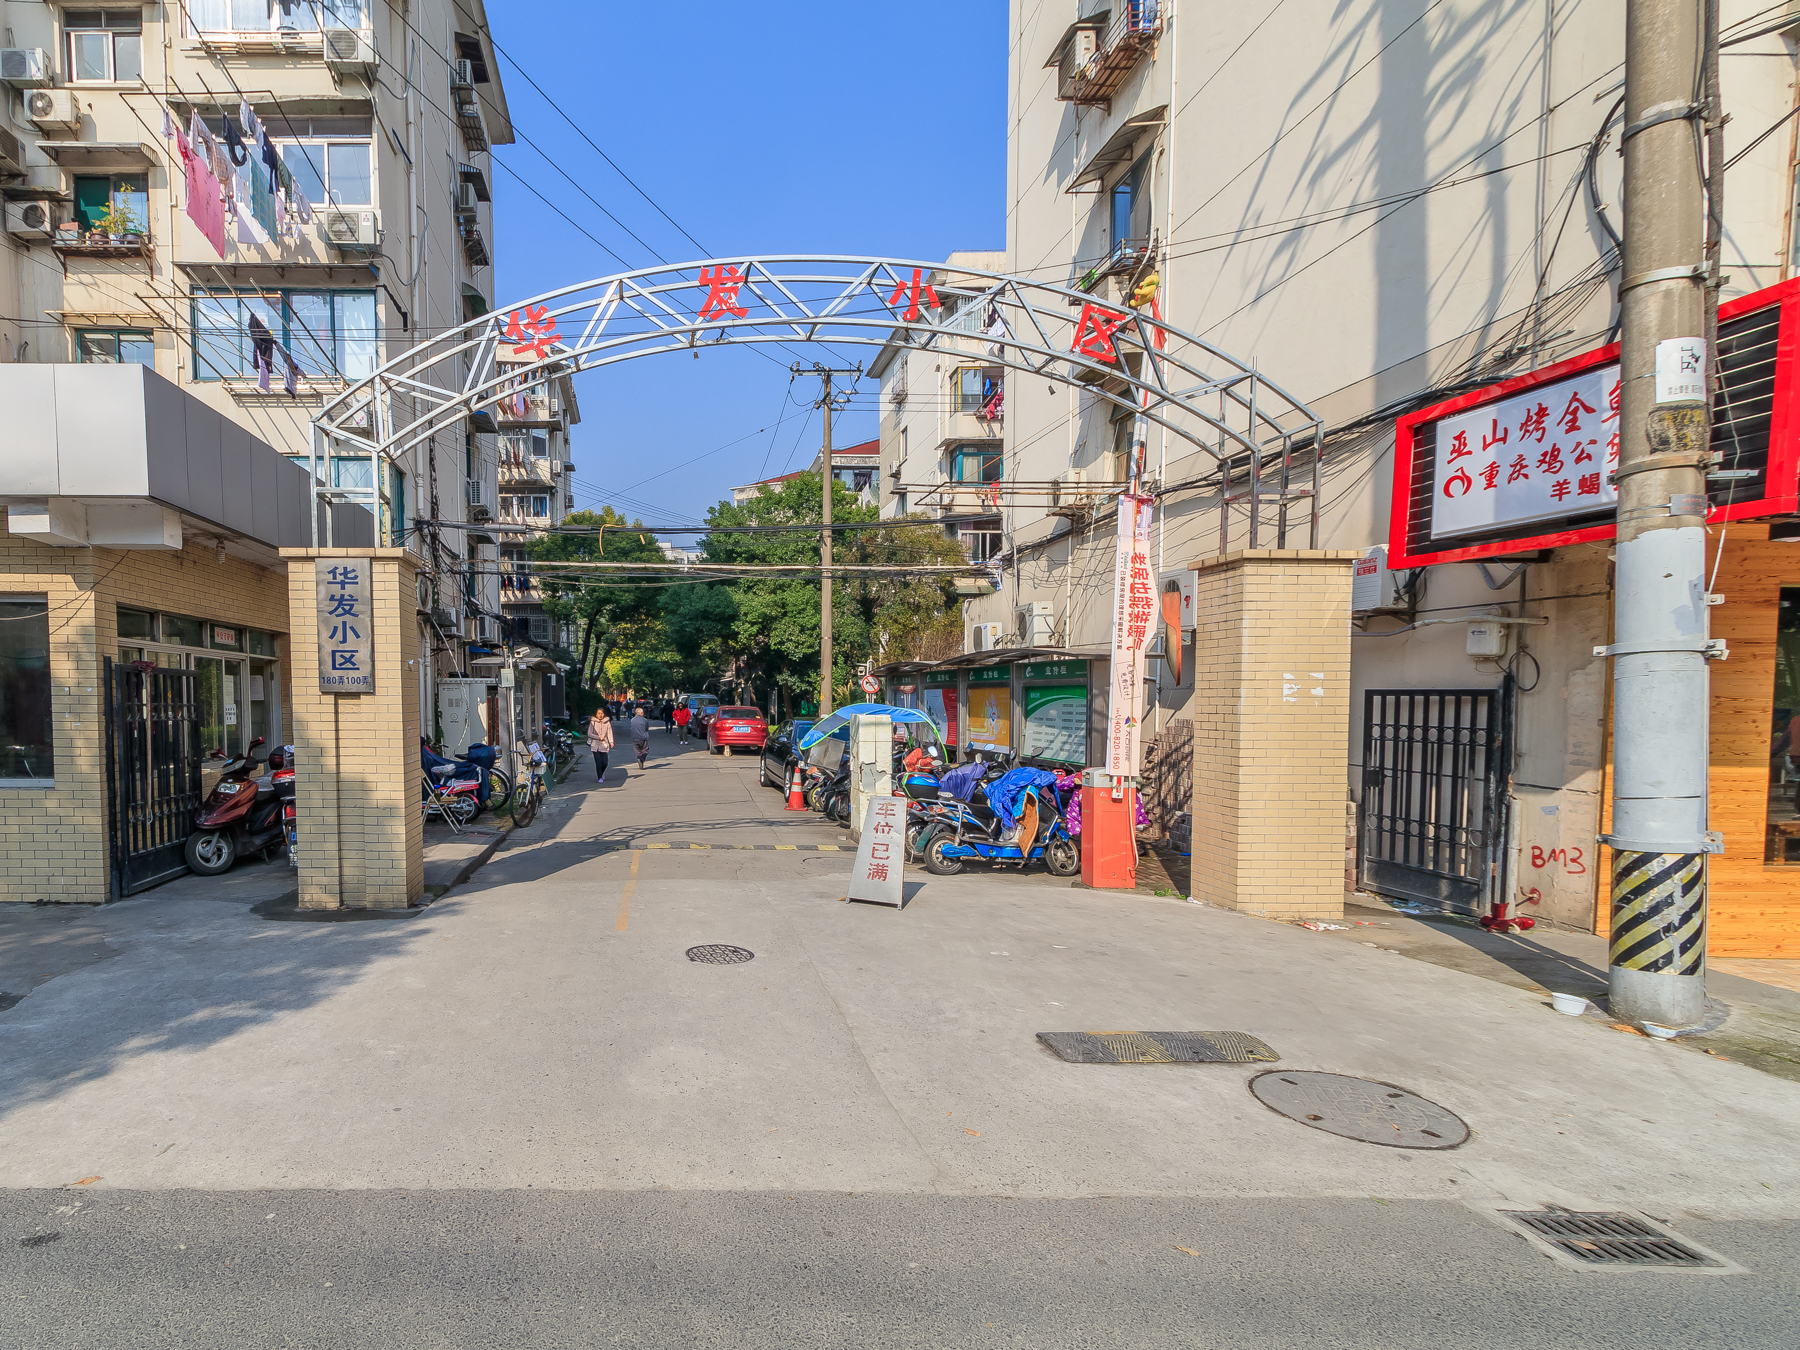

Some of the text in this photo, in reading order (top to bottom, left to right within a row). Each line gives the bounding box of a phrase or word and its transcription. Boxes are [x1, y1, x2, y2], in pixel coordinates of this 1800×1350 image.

[505, 264, 1127, 364] 华发小区
[327, 566, 361, 671] 华发小区
[1126, 552, 1154, 651] 老房也能装暖气
[321, 676, 370, 686] 180弄100弄
[1112, 720, 1121, 770] 400-820-1850
[866, 802, 897, 882] 车位已满
